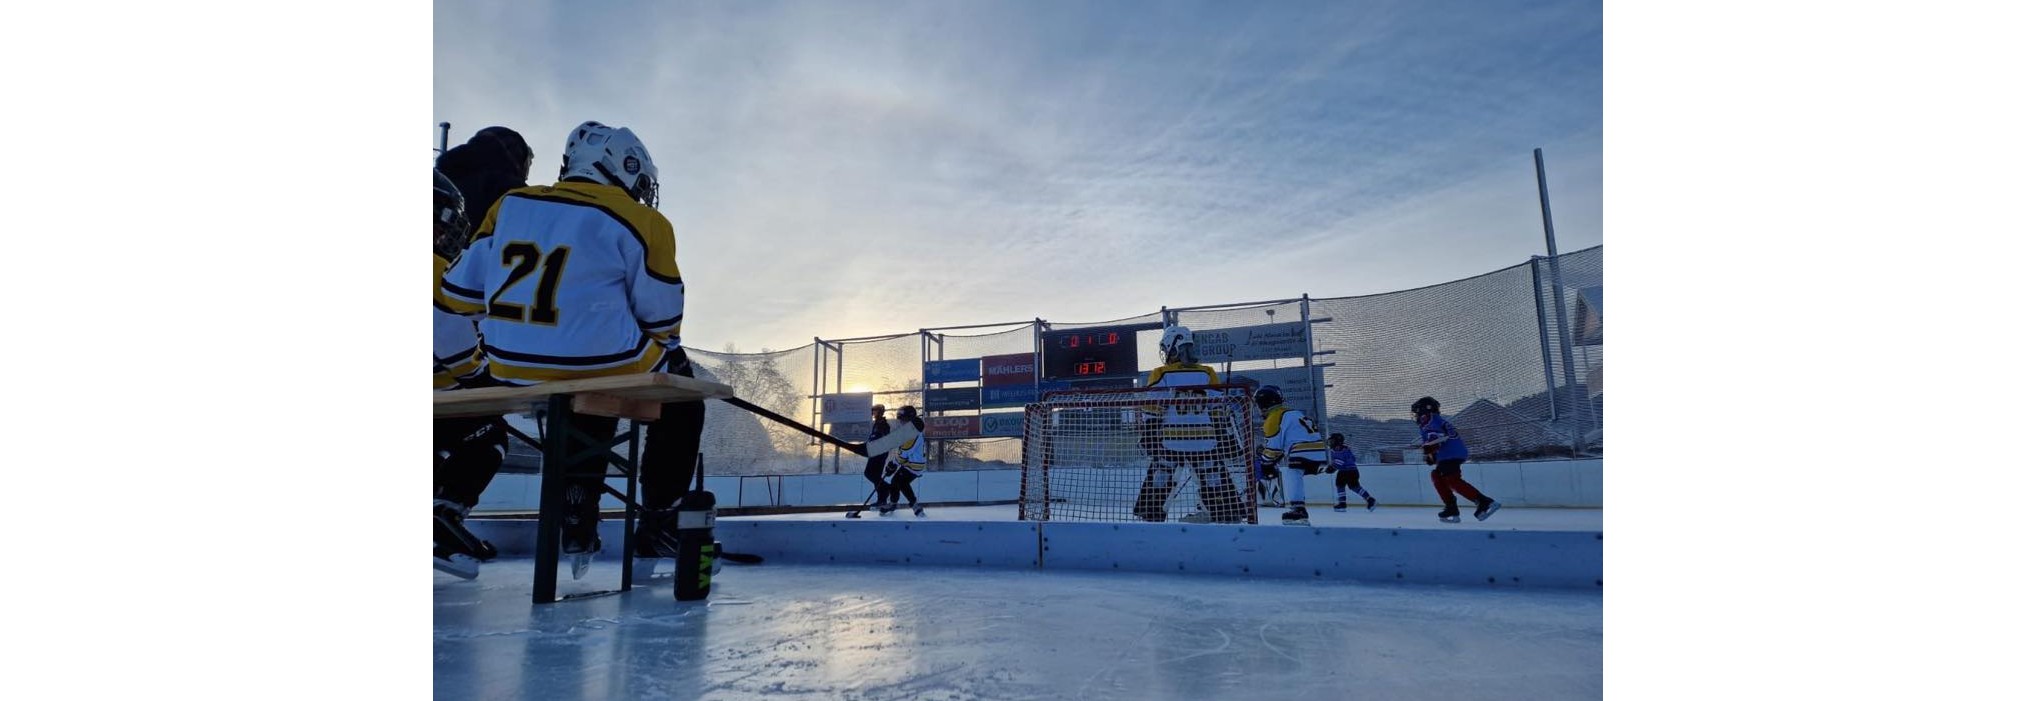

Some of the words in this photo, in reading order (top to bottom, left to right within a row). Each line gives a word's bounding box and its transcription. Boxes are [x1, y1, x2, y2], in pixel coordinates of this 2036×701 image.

[486, 241, 572, 327] 21
[1108, 333, 1117, 345] 0
[1201, 344, 1237, 356] GROUP
